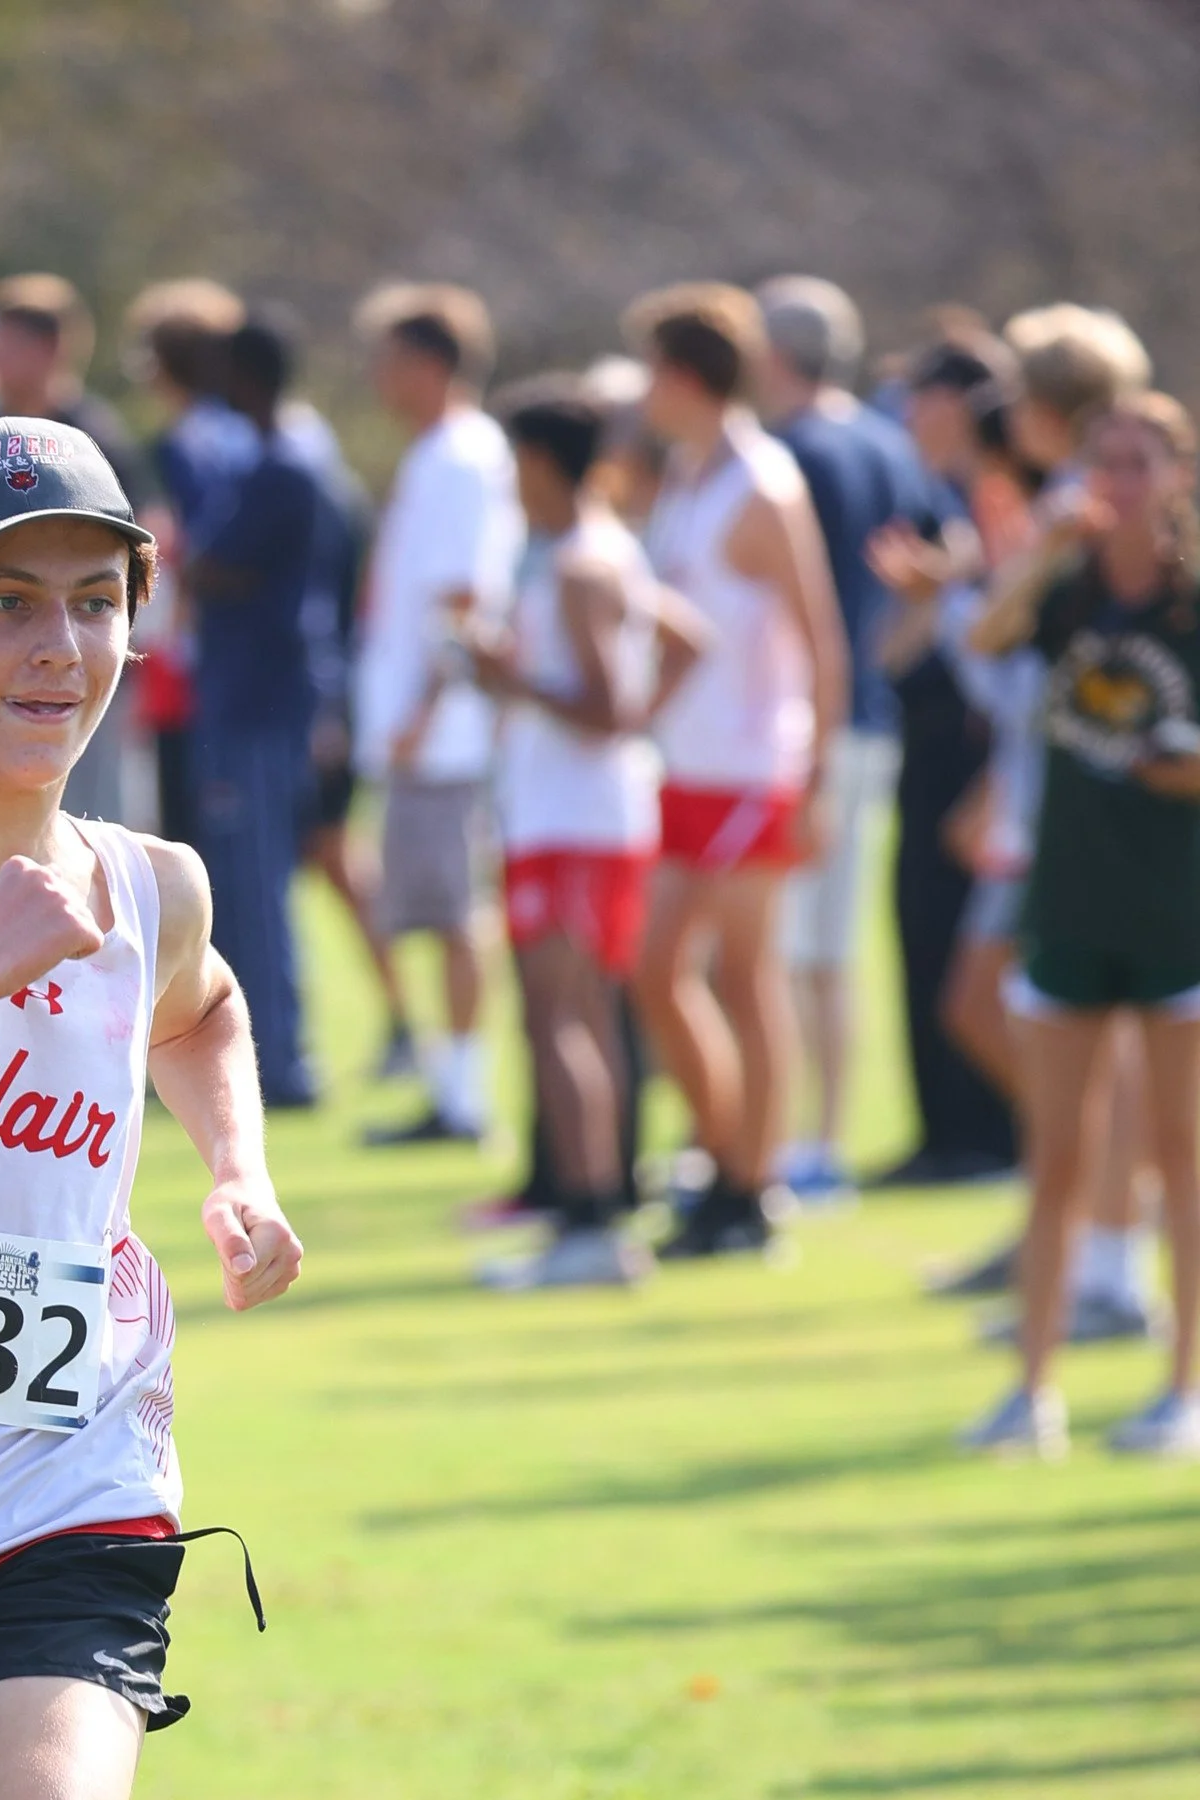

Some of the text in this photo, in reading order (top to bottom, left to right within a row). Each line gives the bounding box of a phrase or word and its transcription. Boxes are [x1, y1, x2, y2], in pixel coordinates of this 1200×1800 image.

[15, 456, 29, 466] &
[30, 454, 69, 465] FIELD
[0, 1254, 26, 1265] ANNUAL
[18, 1264, 38, 1275] PREP
